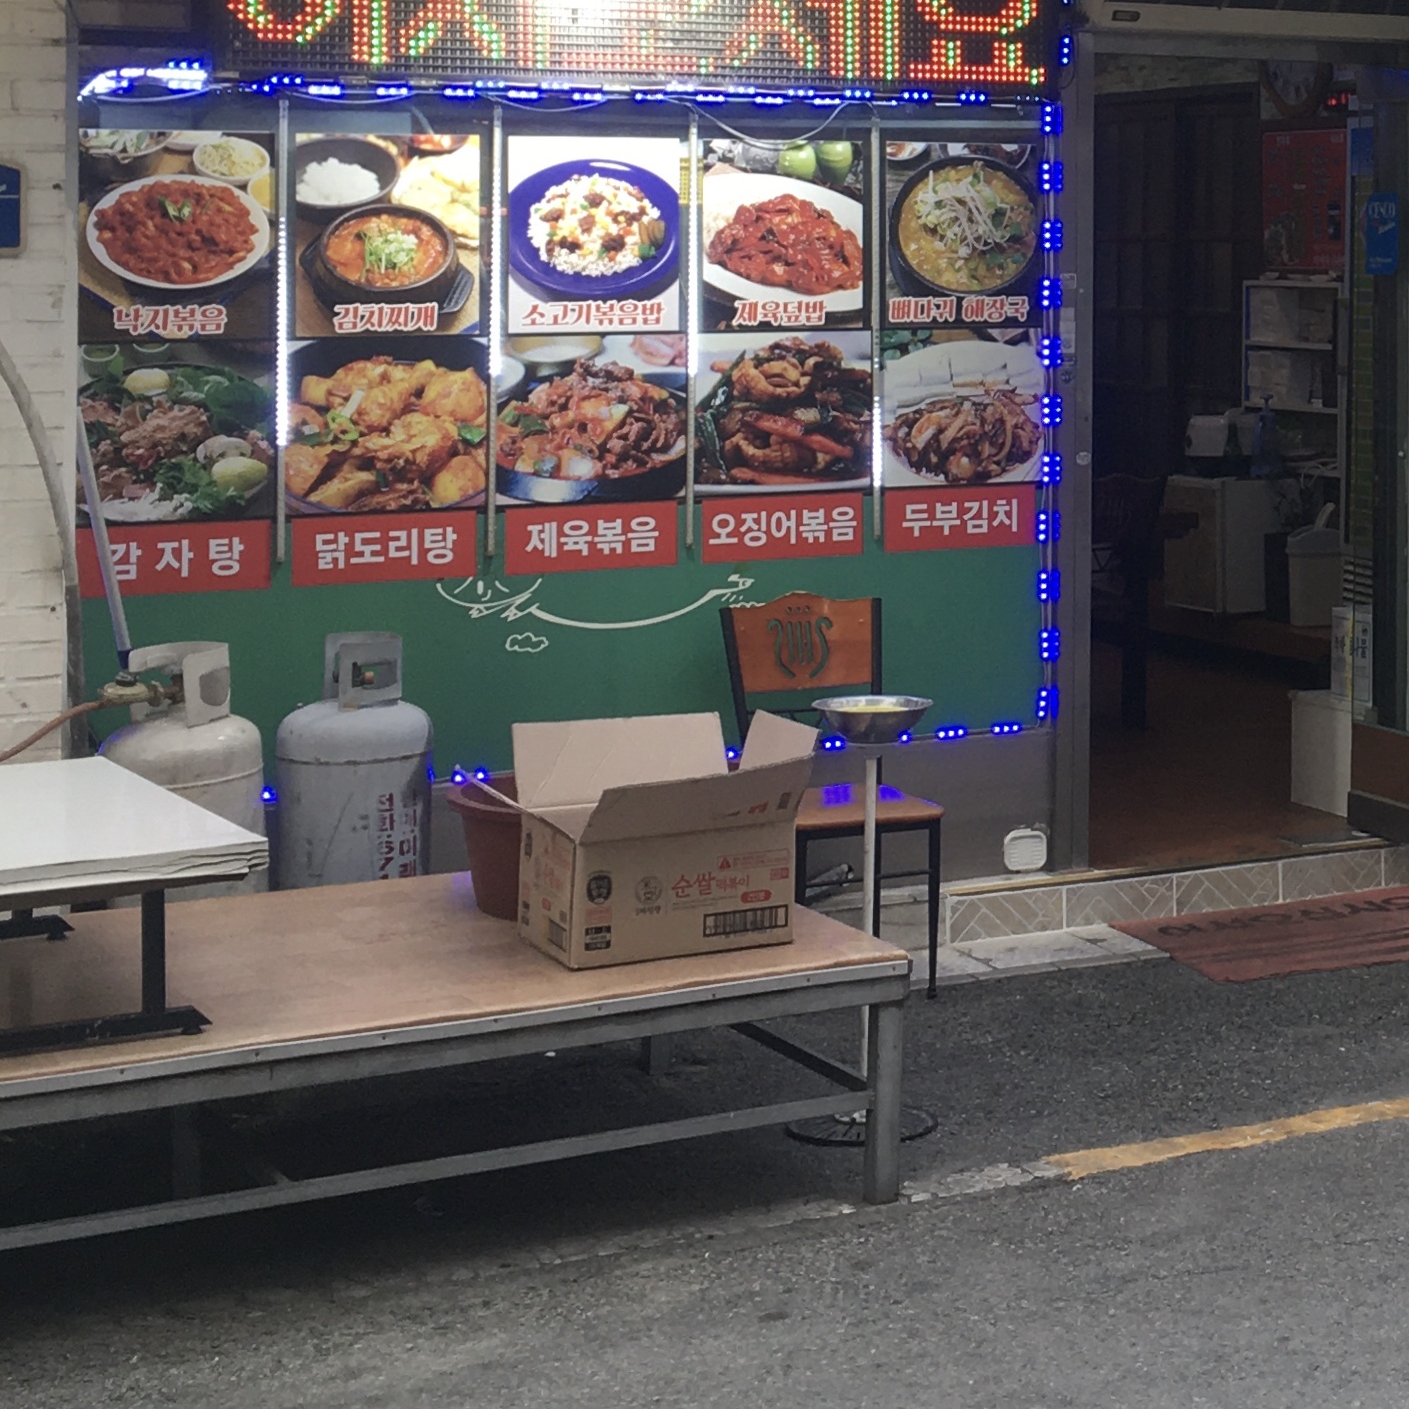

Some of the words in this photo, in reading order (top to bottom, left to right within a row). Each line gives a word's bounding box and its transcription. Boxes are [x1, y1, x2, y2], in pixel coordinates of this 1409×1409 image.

[111, 302, 228, 335] 낙지볶음
[332, 301, 440, 334] 김치찌개
[520, 299, 666, 328] 소고기볶음밥
[732, 298, 828, 327] 제육덮밥
[888, 297, 957, 324] 뼈다귀
[961, 295, 1031, 323] 해장국
[708, 505, 858, 548] 오징어볶음
[901, 497, 1020, 538] 두부김치
[314, 526, 459, 571] 닭도리탕
[525, 516, 660, 559] 제육볶음
[111, 536, 245, 581] 감자탕
